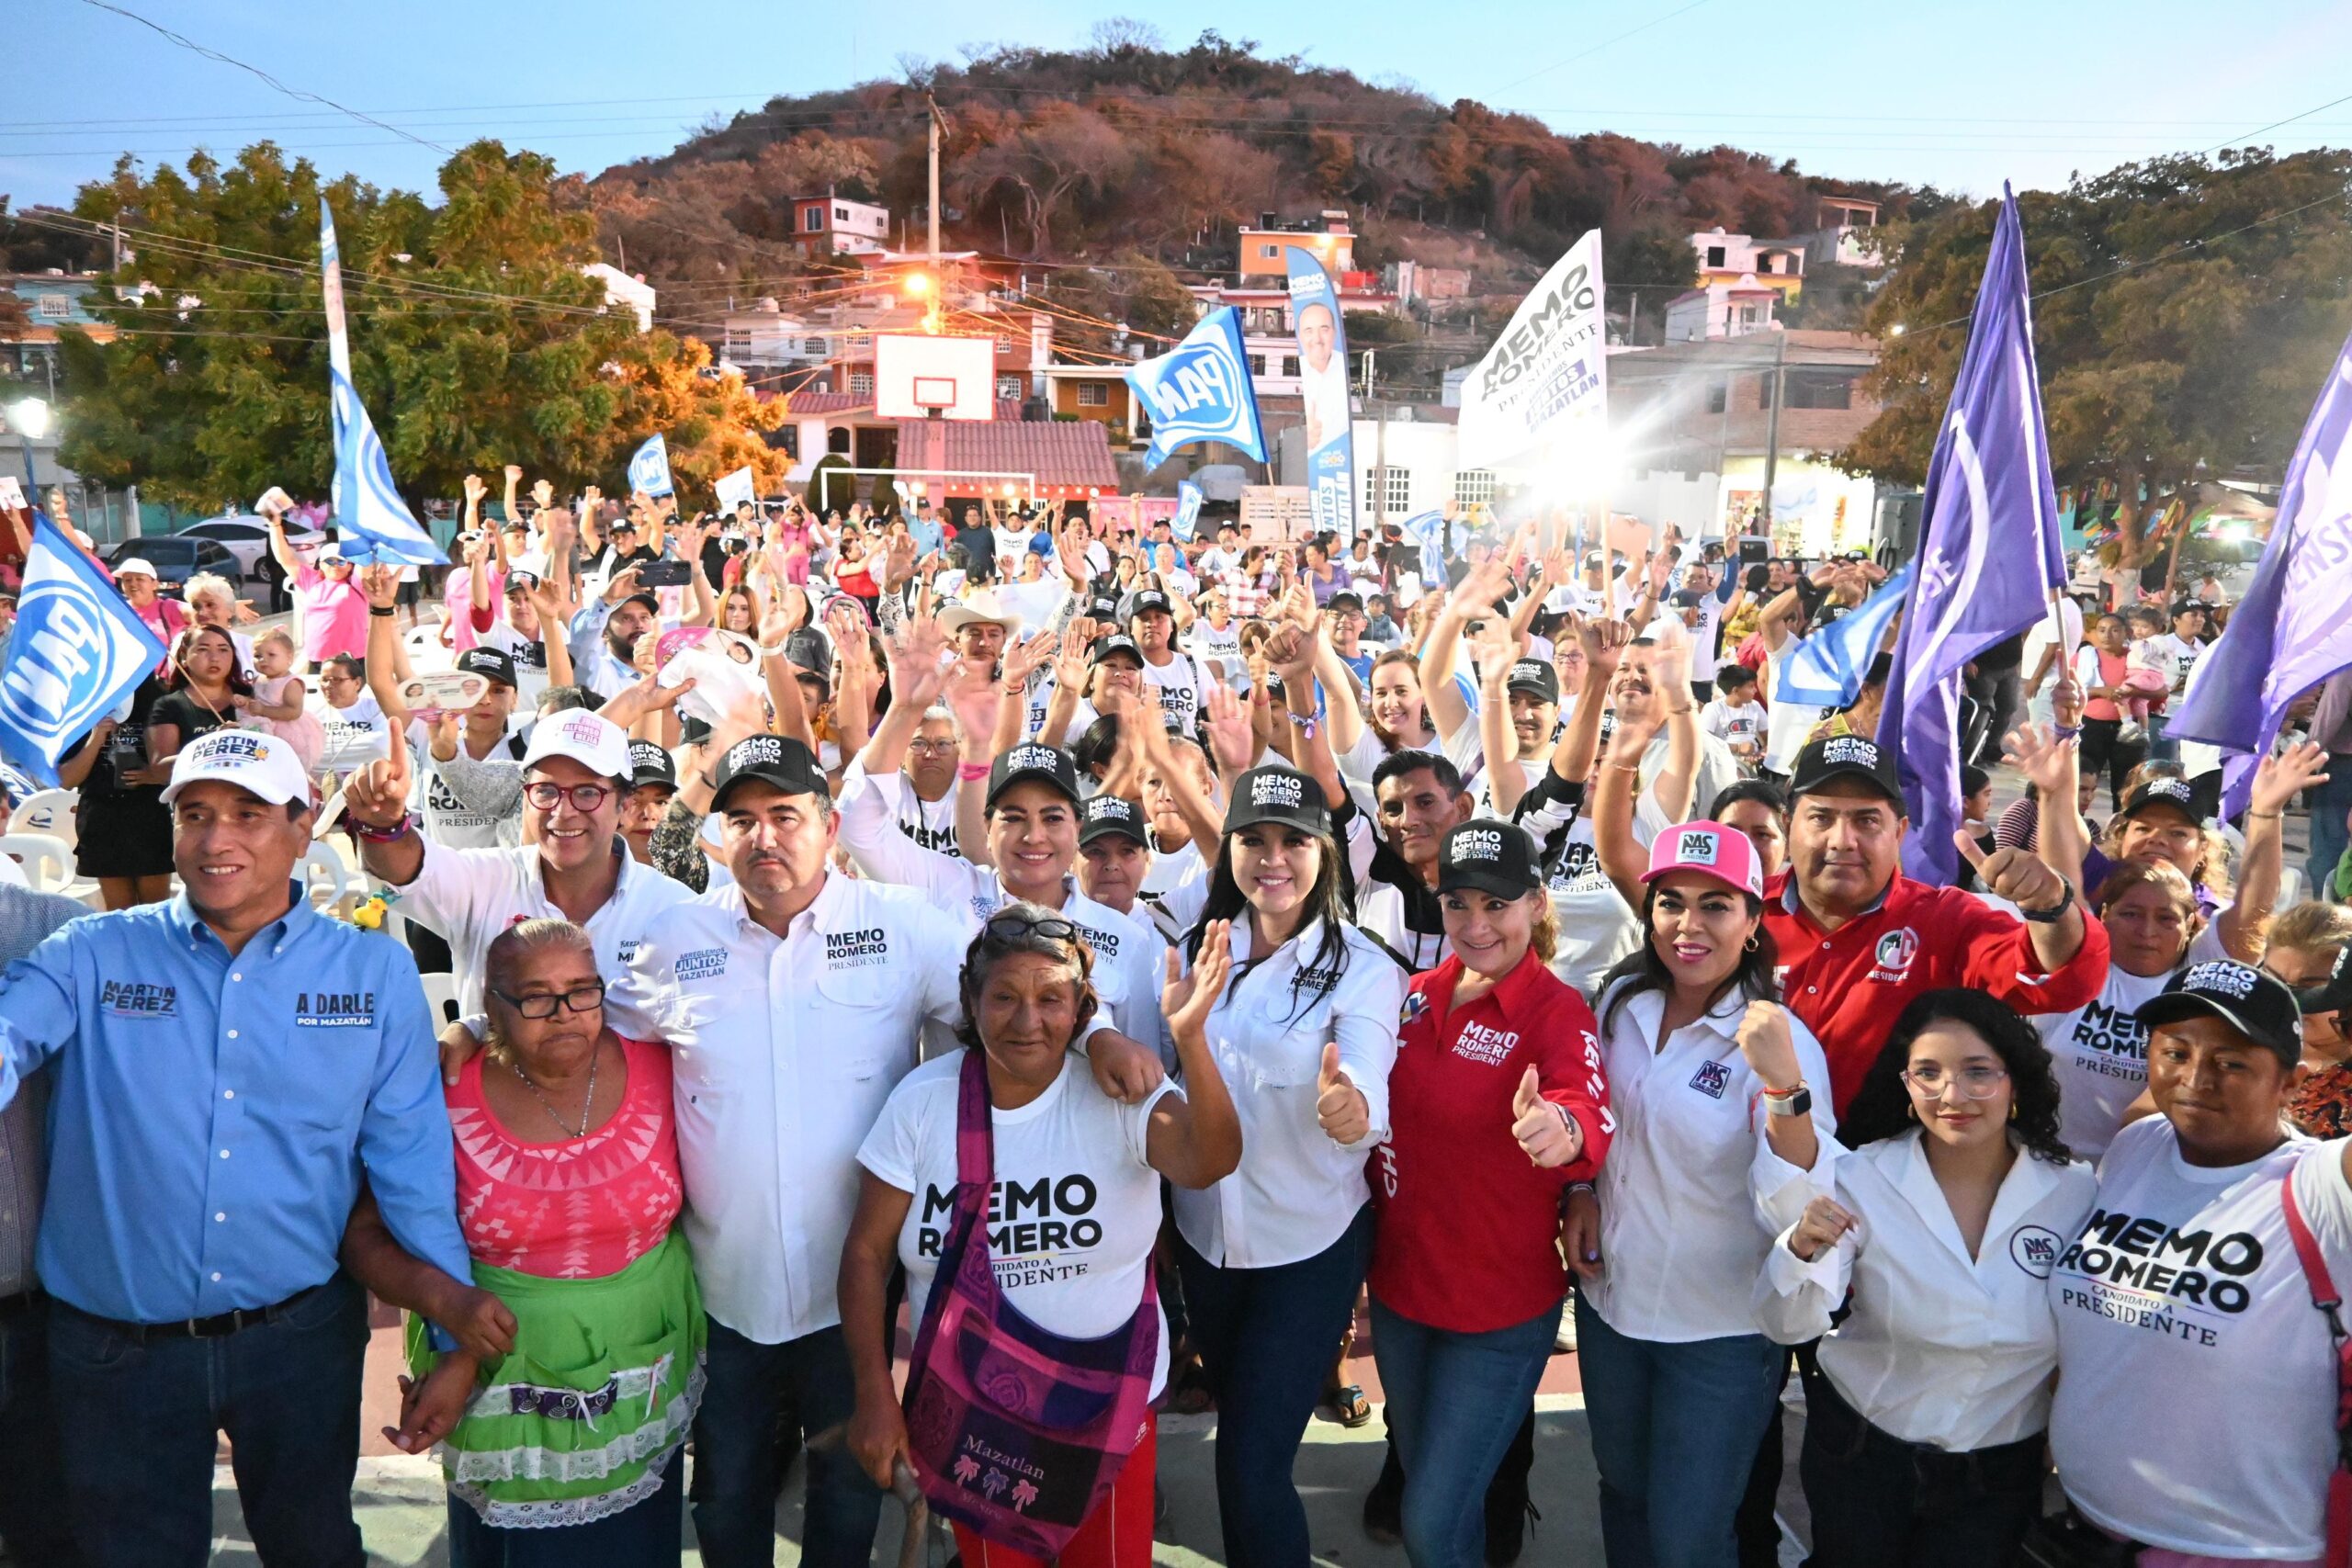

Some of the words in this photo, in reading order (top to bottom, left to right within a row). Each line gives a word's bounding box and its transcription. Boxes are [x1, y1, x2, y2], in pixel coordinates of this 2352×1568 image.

[1483, 263, 1589, 391] MEMO
[1208, 642, 1238, 652] MEMO
[563, 724, 601, 737] ALFONSO
[192, 744, 256, 761] PEREZ
[194, 736, 259, 752] MARTIN
[730, 738, 781, 760] MEMO
[1825, 738, 1878, 755] MEMO
[1009, 747, 1057, 761] MEMO
[1823, 747, 1878, 762] ROMERO
[1252, 774, 1302, 790] MEMO
[1251, 785, 1302, 799] ROMERO
[1089, 796, 1129, 808] MEMO
[1252, 797, 1300, 808] PRESIDENTE
[1453, 829, 1501, 846] MEMO
[1681, 834, 1713, 855] PAS
[1452, 840, 1501, 857] ROMERO
[827, 928, 885, 948] MEMO
[680, 947, 725, 960] ARREGLEMOS
[827, 942, 888, 960] ROMERO
[675, 953, 727, 973] JUNTOS
[828, 955, 888, 971] PRESIDENTE
[677, 967, 725, 982] MAZATLÁN
[1295, 964, 1343, 983] MEMO
[2189, 962, 2257, 983] MEMO
[105, 979, 177, 998] MARTIN
[2183, 973, 2254, 992] ROMERO
[100, 990, 177, 1012] PEREZ
[296, 992, 309, 1013] A
[316, 992, 375, 1015] DARLE
[297, 1017, 318, 1026] POR
[321, 1016, 372, 1026] MAZATLÁN
[1463, 1020, 1520, 1049] MEMO
[922, 1174, 1097, 1224] MEMO
[2022, 1237, 2054, 1260] PAS
[2077, 1209, 2264, 1277] MEMO
[1044, 1258, 1052, 1266] A
[2056, 1244, 2250, 1314] ROMERO
[2091, 1285, 2160, 1310] CANDIDATO
[2164, 1304, 2174, 1314] A
[2063, 1288, 2217, 1348] PRESIDENTE
[965, 1434, 1045, 1480] Mazatlan
